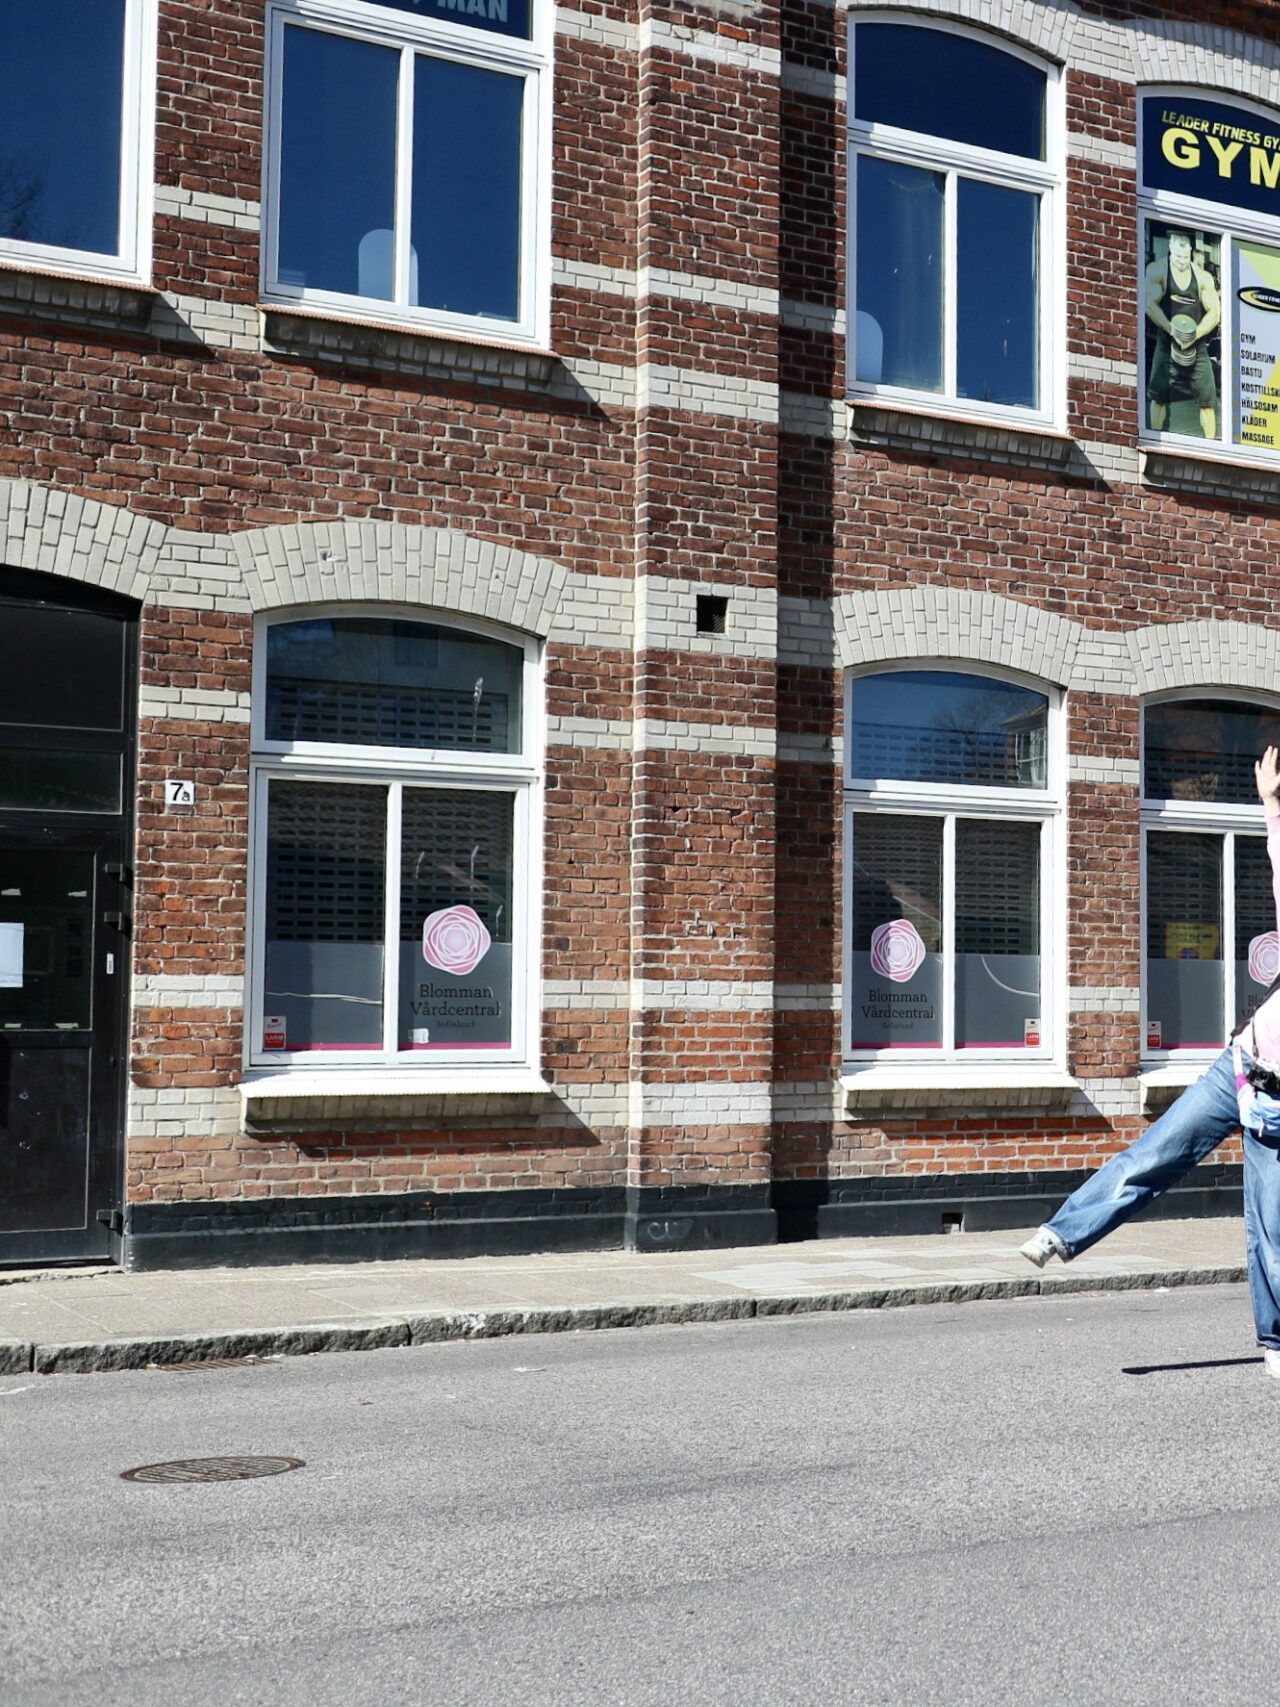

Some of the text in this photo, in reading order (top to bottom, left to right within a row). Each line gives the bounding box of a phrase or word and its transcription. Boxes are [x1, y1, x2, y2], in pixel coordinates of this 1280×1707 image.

[1161, 110, 1209, 133] LEADER
[1212, 123, 1261, 146] FITNESS
[1240, 333, 1256, 345] GYM
[1240, 349, 1276, 364] SOLARIUM
[1241, 366, 1262, 378] BASTU
[1241, 397, 1278, 413] HÄLSOSAM
[1241, 414, 1267, 428] KLÄDER
[1242, 431, 1274, 445] MASSAGE
[170, 782, 190, 801] 7a
[419, 983, 492, 998] Blomman
[868, 988, 928, 1002] Blomman
[409, 1000, 500, 1016] Vårdcentral
[861, 1004, 934, 1019] Vårdcentral
